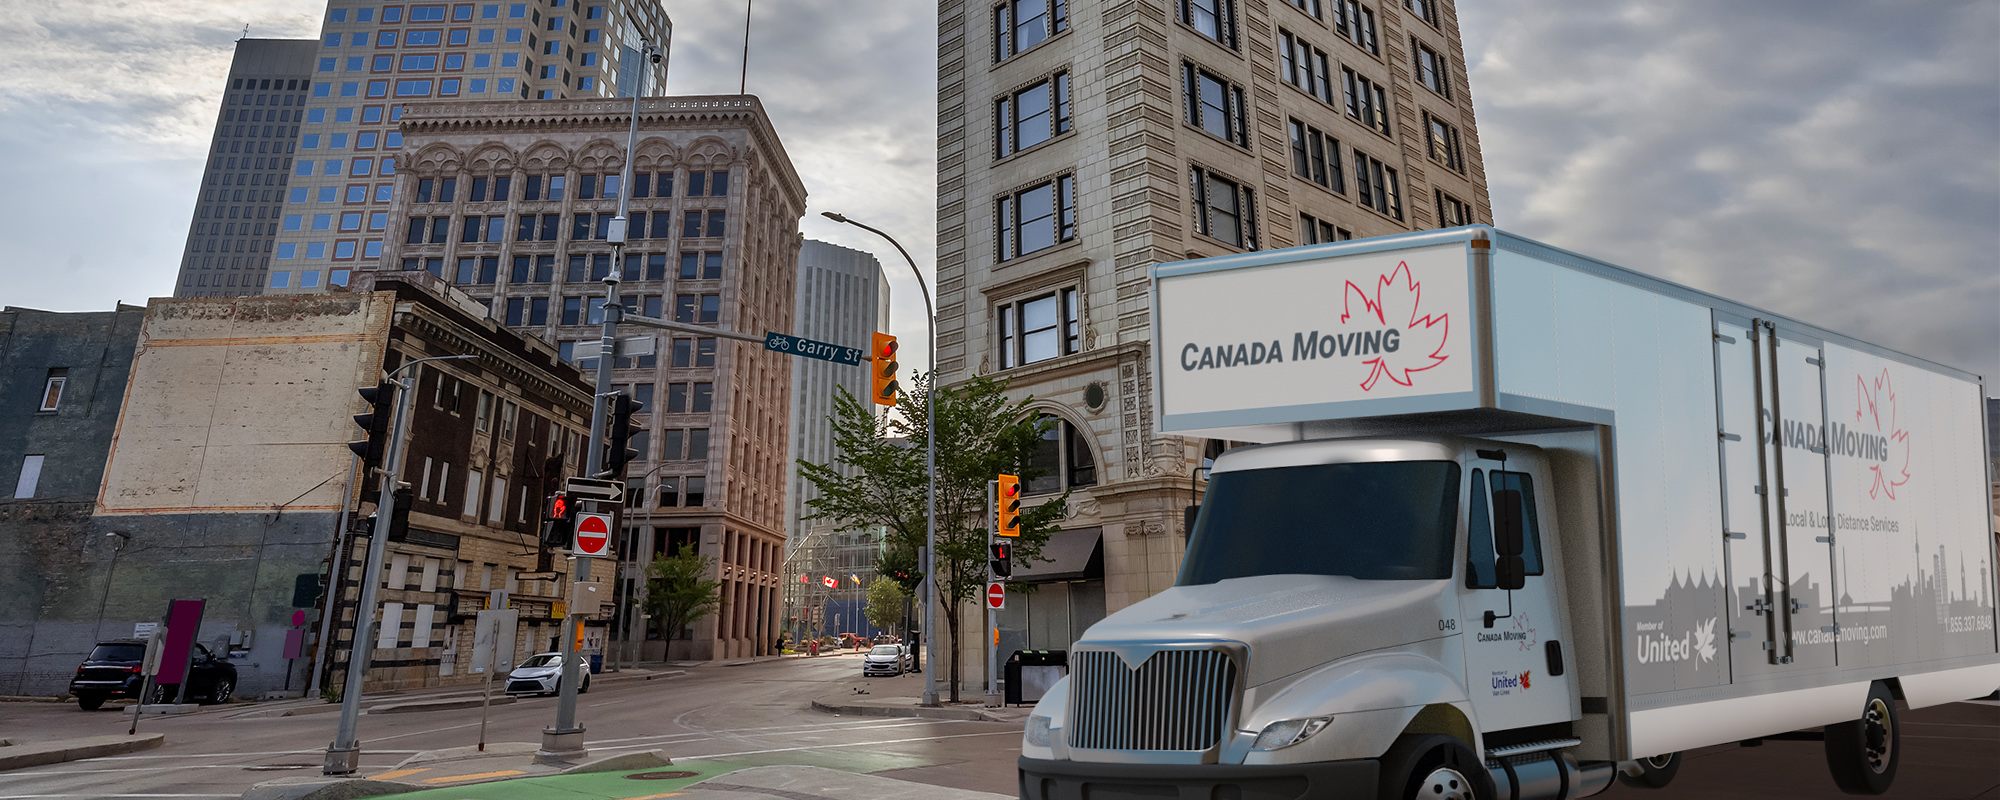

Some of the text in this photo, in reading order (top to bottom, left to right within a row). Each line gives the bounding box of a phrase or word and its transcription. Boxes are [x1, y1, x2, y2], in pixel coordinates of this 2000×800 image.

[797, 339, 860, 362] Garry St
[1181, 328, 1400, 371] CANADA MOVING
[1832, 421, 1888, 462] MOVING
[1785, 510, 1899, 534] Local & Log Distance Services
[1438, 619, 1456, 631] 048
[1477, 631, 1526, 642] CANADA MOVING
[1637, 621, 1664, 631] Member of
[1638, 630, 1690, 664] United
[1491, 675, 1517, 689] United
